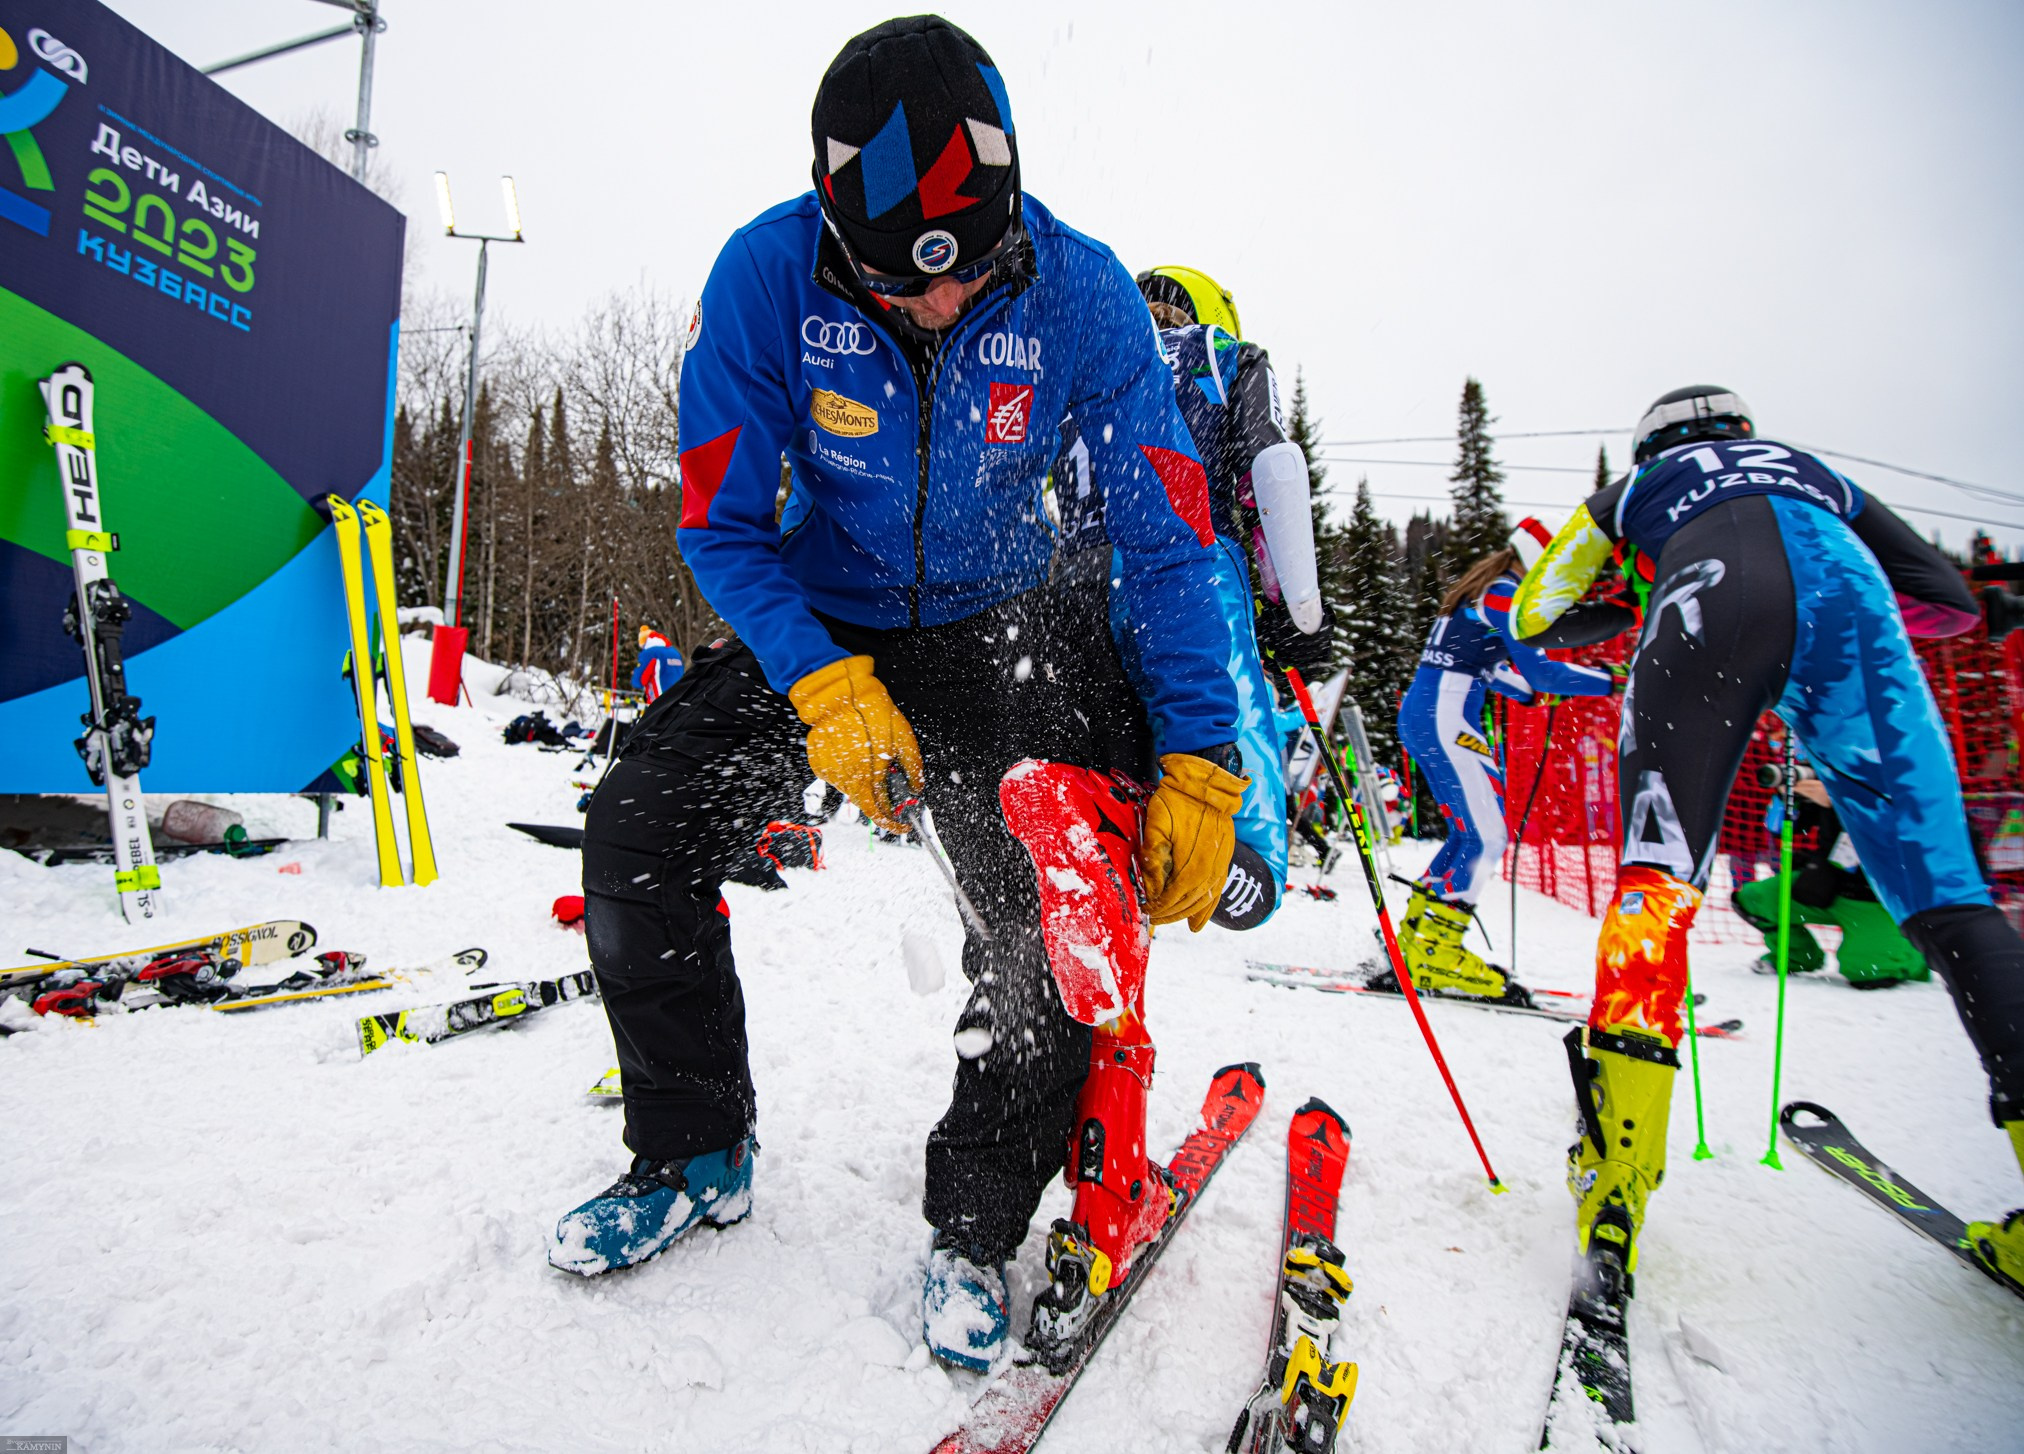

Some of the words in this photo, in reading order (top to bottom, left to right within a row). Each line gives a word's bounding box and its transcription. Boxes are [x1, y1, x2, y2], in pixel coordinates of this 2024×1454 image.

[91, 122, 180, 194] Дети
[187, 179, 260, 239] Азии
[83, 168, 257, 292] 2023
[77, 229, 253, 332] КУЗБАСС
[802, 352, 834, 369] Audi
[818, 443, 829, 456] La
[831, 449, 867, 470] Région
[1677, 444, 1799, 474] 12
[1345, 798, 1371, 855] LEKI
